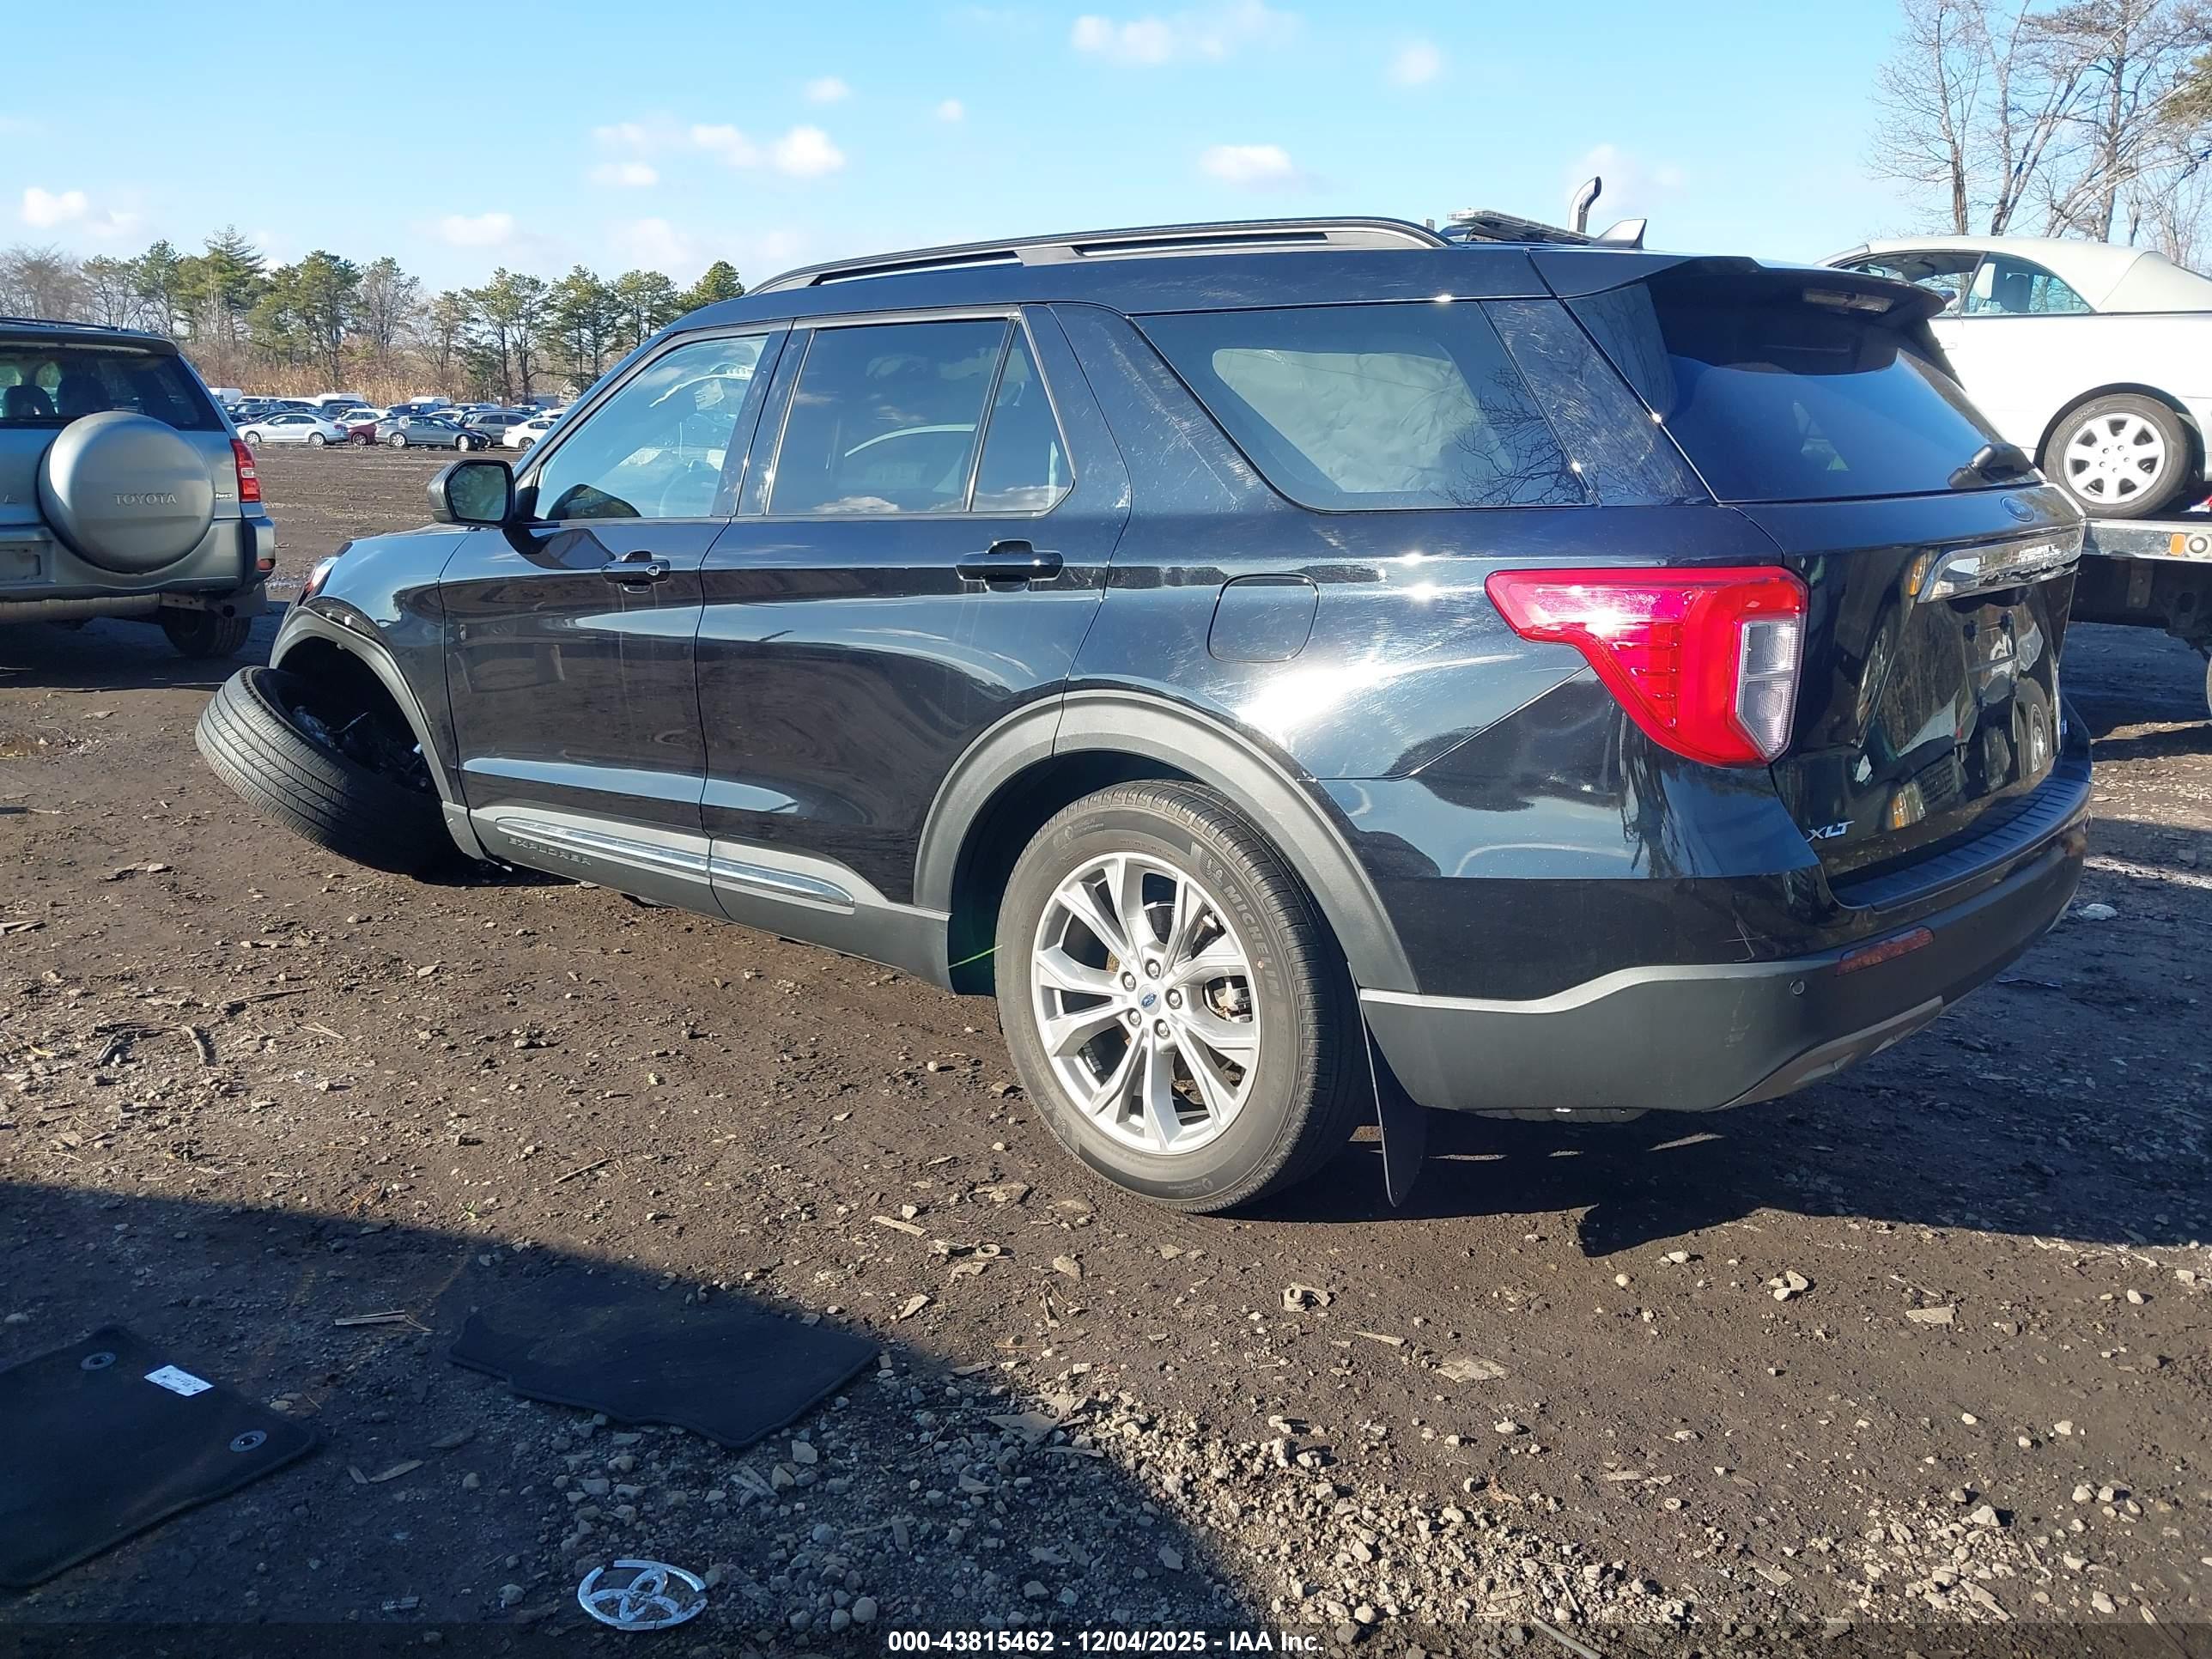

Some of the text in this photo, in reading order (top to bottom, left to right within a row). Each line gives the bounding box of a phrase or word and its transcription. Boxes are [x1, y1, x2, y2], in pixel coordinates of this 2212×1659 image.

[114, 493, 177, 507] TOYOTA
[1806, 820, 1856, 842] XLT
[508, 836, 592, 866] EXPLORER
[1223, 884, 1281, 997] MICHELIN
